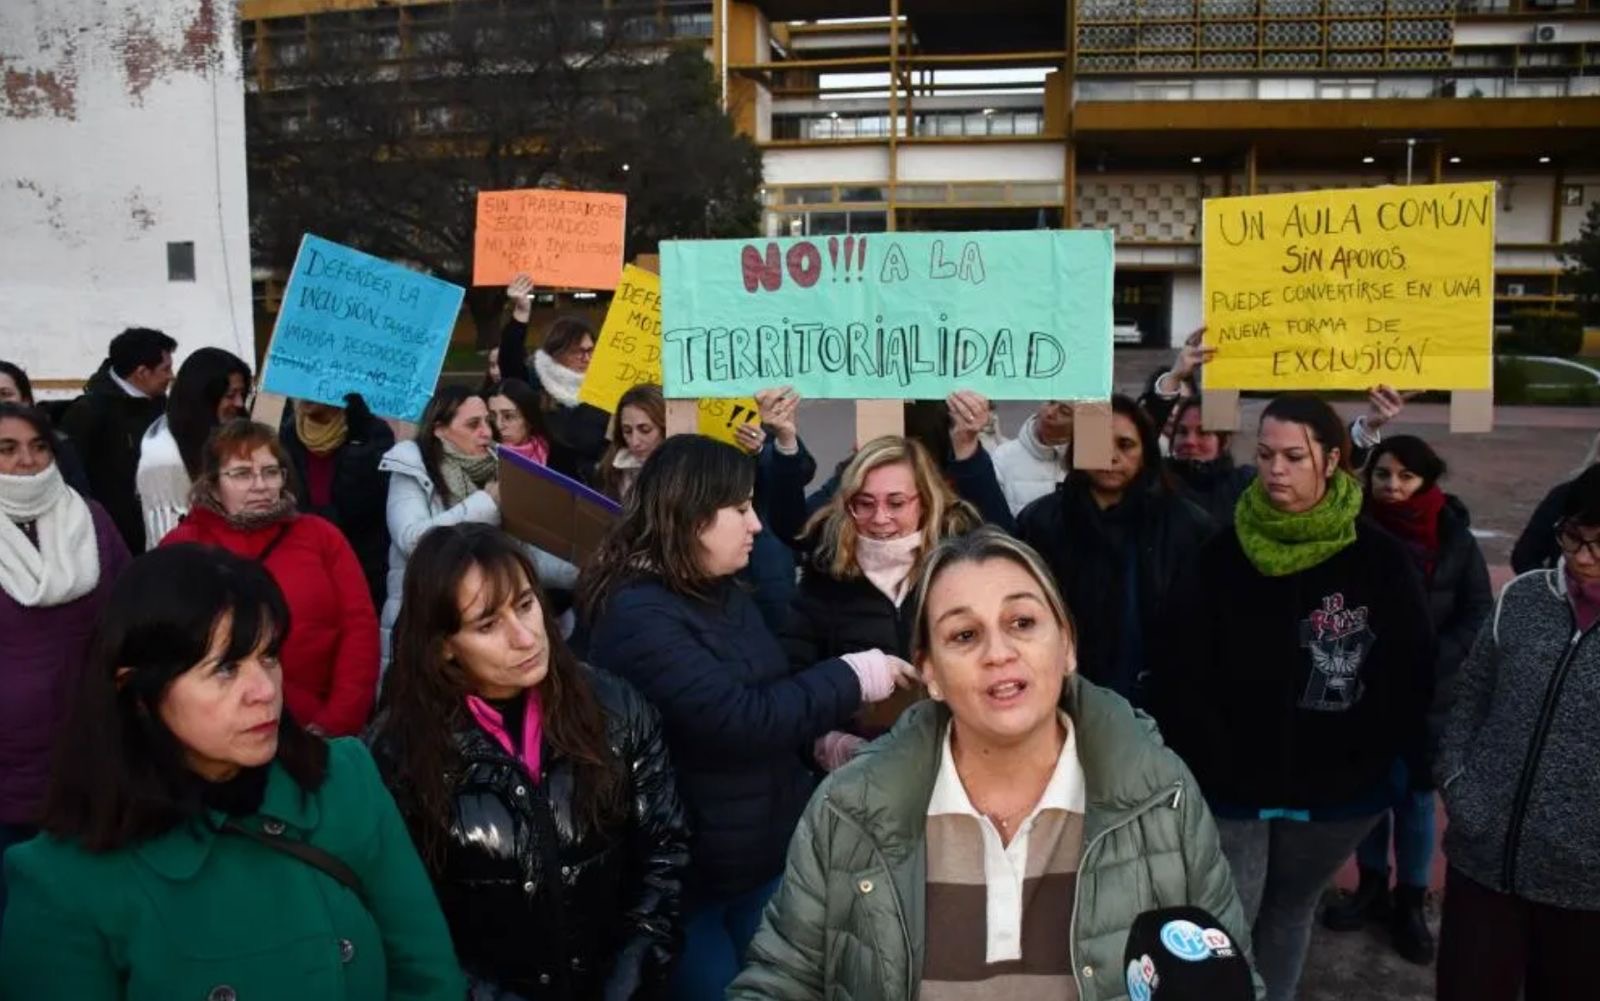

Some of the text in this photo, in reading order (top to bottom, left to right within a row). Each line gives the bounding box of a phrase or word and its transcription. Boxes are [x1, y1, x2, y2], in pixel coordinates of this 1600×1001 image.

[1219, 191, 1489, 247] UN AULA COMÚN
[302, 248, 421, 310] DEFENDER LA
[879, 241, 911, 284] A
[929, 239, 987, 285] LA
[1212, 289, 1273, 313] PUEDE
[1406, 279, 1433, 299] EN
[1443, 277, 1482, 299] UNA
[609, 331, 638, 354] ES
[1218, 316, 1402, 345] NUEVA FORMA DE
